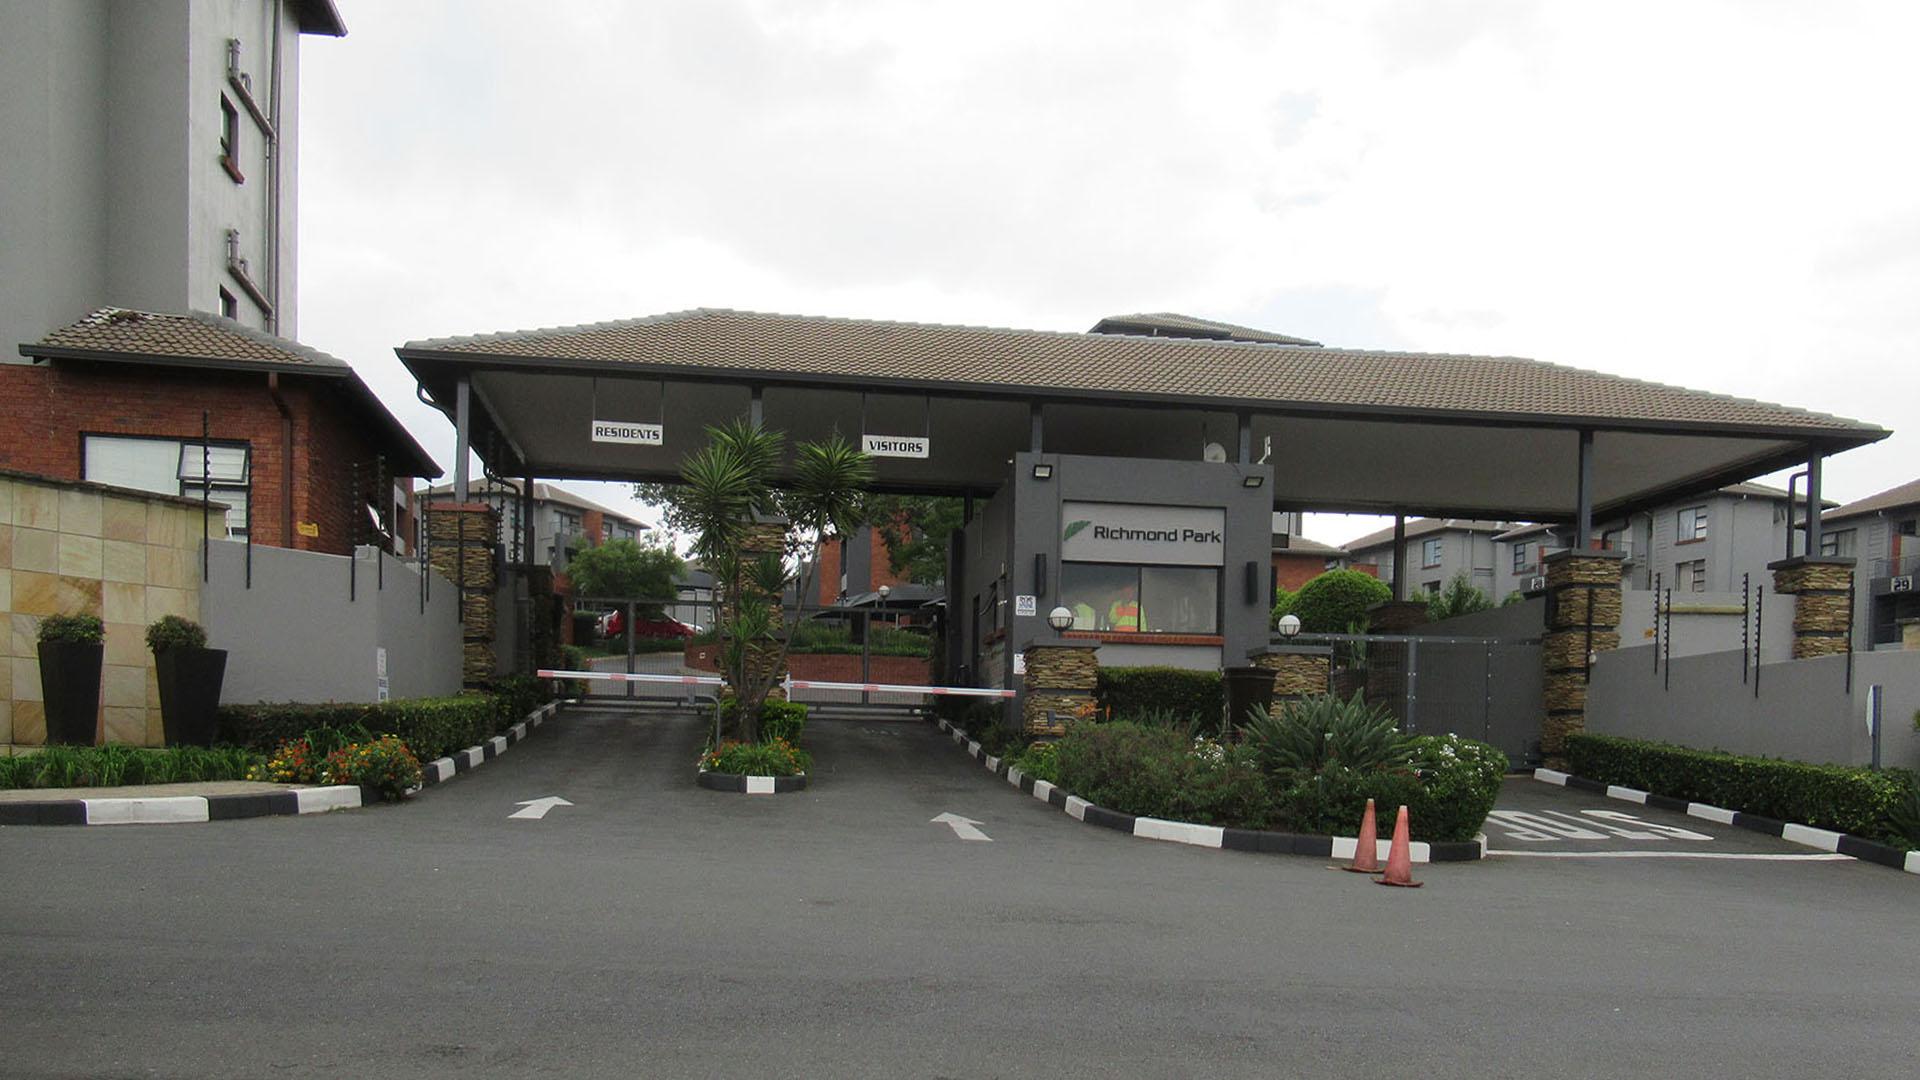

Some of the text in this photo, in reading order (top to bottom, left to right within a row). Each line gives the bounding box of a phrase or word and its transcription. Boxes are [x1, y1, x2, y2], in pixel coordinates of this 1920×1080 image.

[595, 426, 660, 440] RESIDENTS
[869, 440, 923, 453] VISITORS
[1094, 525, 1222, 543] Richmond Park
[1894, 579, 1910, 591] 29
[1484, 810, 1715, 841] STOP
